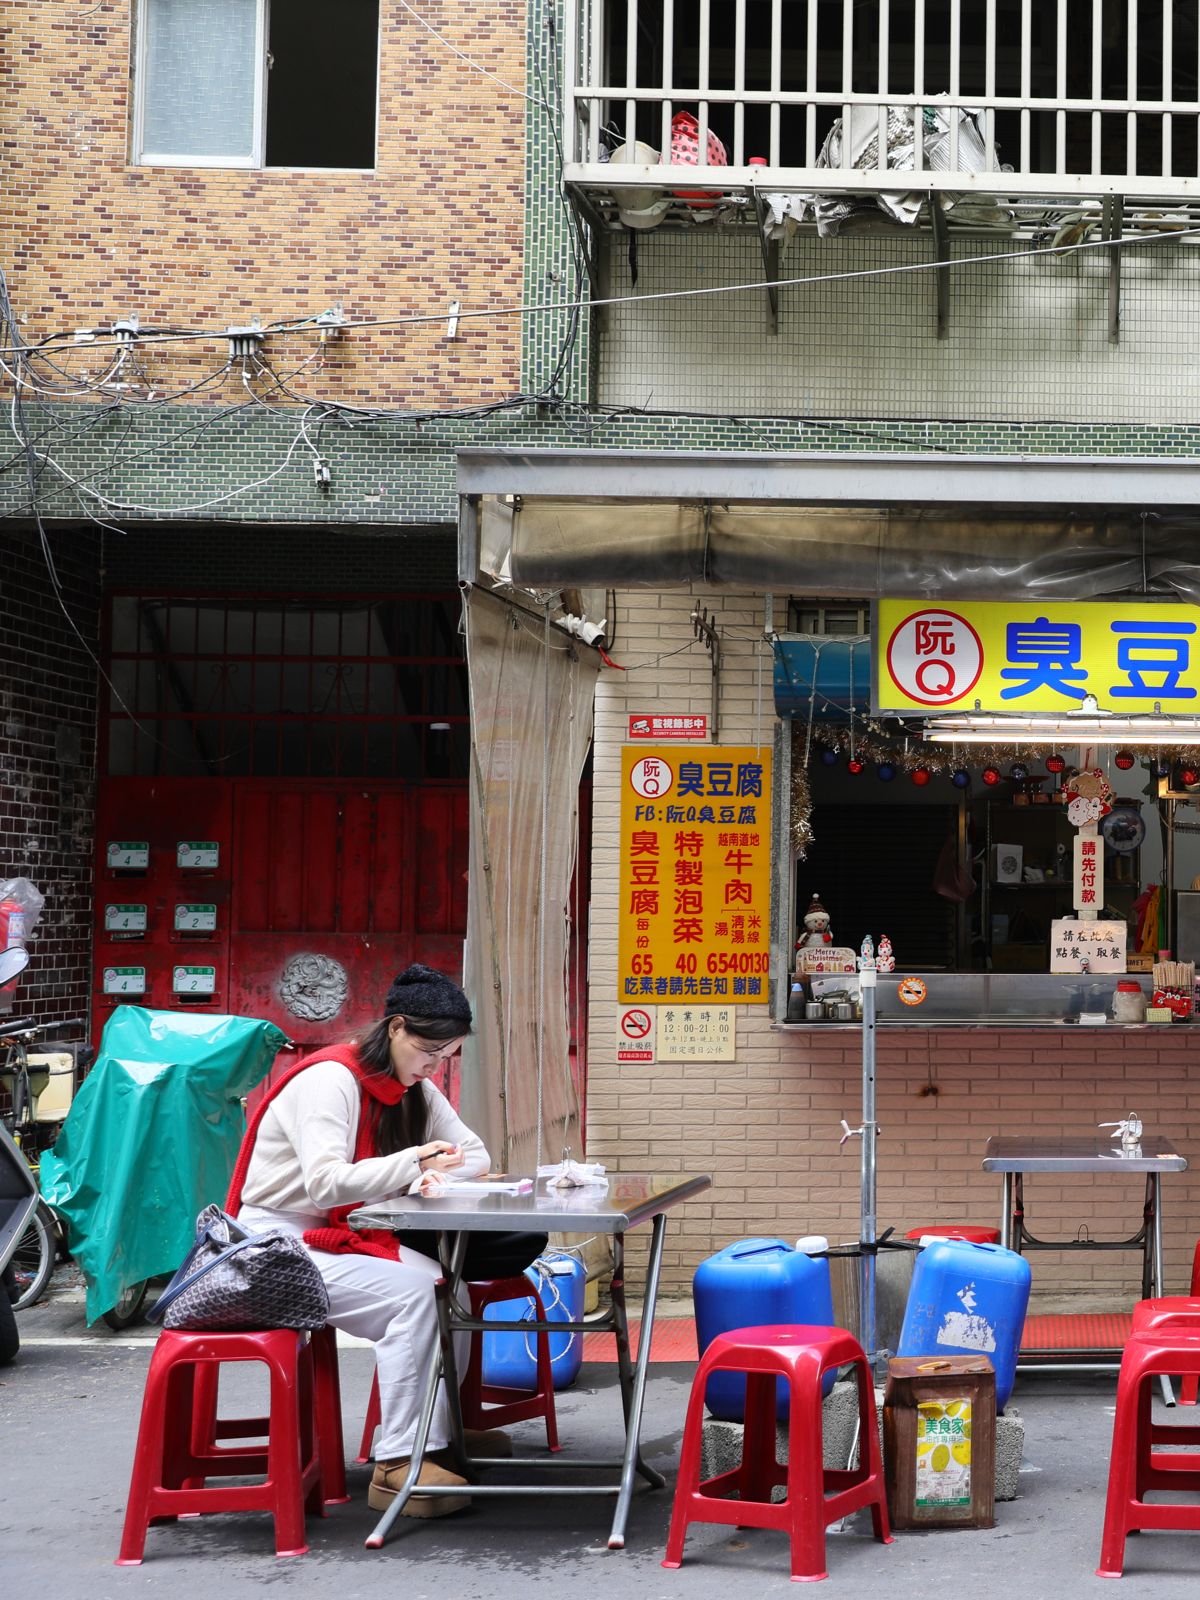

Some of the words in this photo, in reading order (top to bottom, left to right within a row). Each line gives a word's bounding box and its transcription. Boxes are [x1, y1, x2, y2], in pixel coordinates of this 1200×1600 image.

[914, 619, 956, 697] 阮Q
[652, 718, 704, 729] 監視錄影中
[643, 760, 660, 795] 阮Q
[677, 761, 763, 797] 臭豆腐
[717, 832, 761, 848] 越南道地
[124, 855, 131, 865] 4
[194, 855, 202, 866] 2
[629, 830, 660, 915] 臭豆腐
[724, 848, 754, 905] 牛肉
[1081, 841, 1096, 903] 請先付款
[673, 830, 704, 944] 特製泡菜
[122, 918, 129, 928] 4
[192, 918, 199, 928] 2
[714, 921, 729, 937] 湯
[747, 914, 762, 944] 米線
[636, 917, 650, 949] 每份
[1063, 929, 1115, 943] 請在此處
[1056, 946, 1122, 960] 點餐、取餐
[631, 953, 653, 976] 65
[675, 953, 697, 975] 40
[121, 981, 128, 991] 4
[190, 980, 198, 990] 2
[624, 976, 728, 996] 吃素者請先告知
[733, 976, 762, 996] 謝謝
[665, 1010, 729, 1022] 營業時間
[925, 1417, 964, 1435] 美食家
